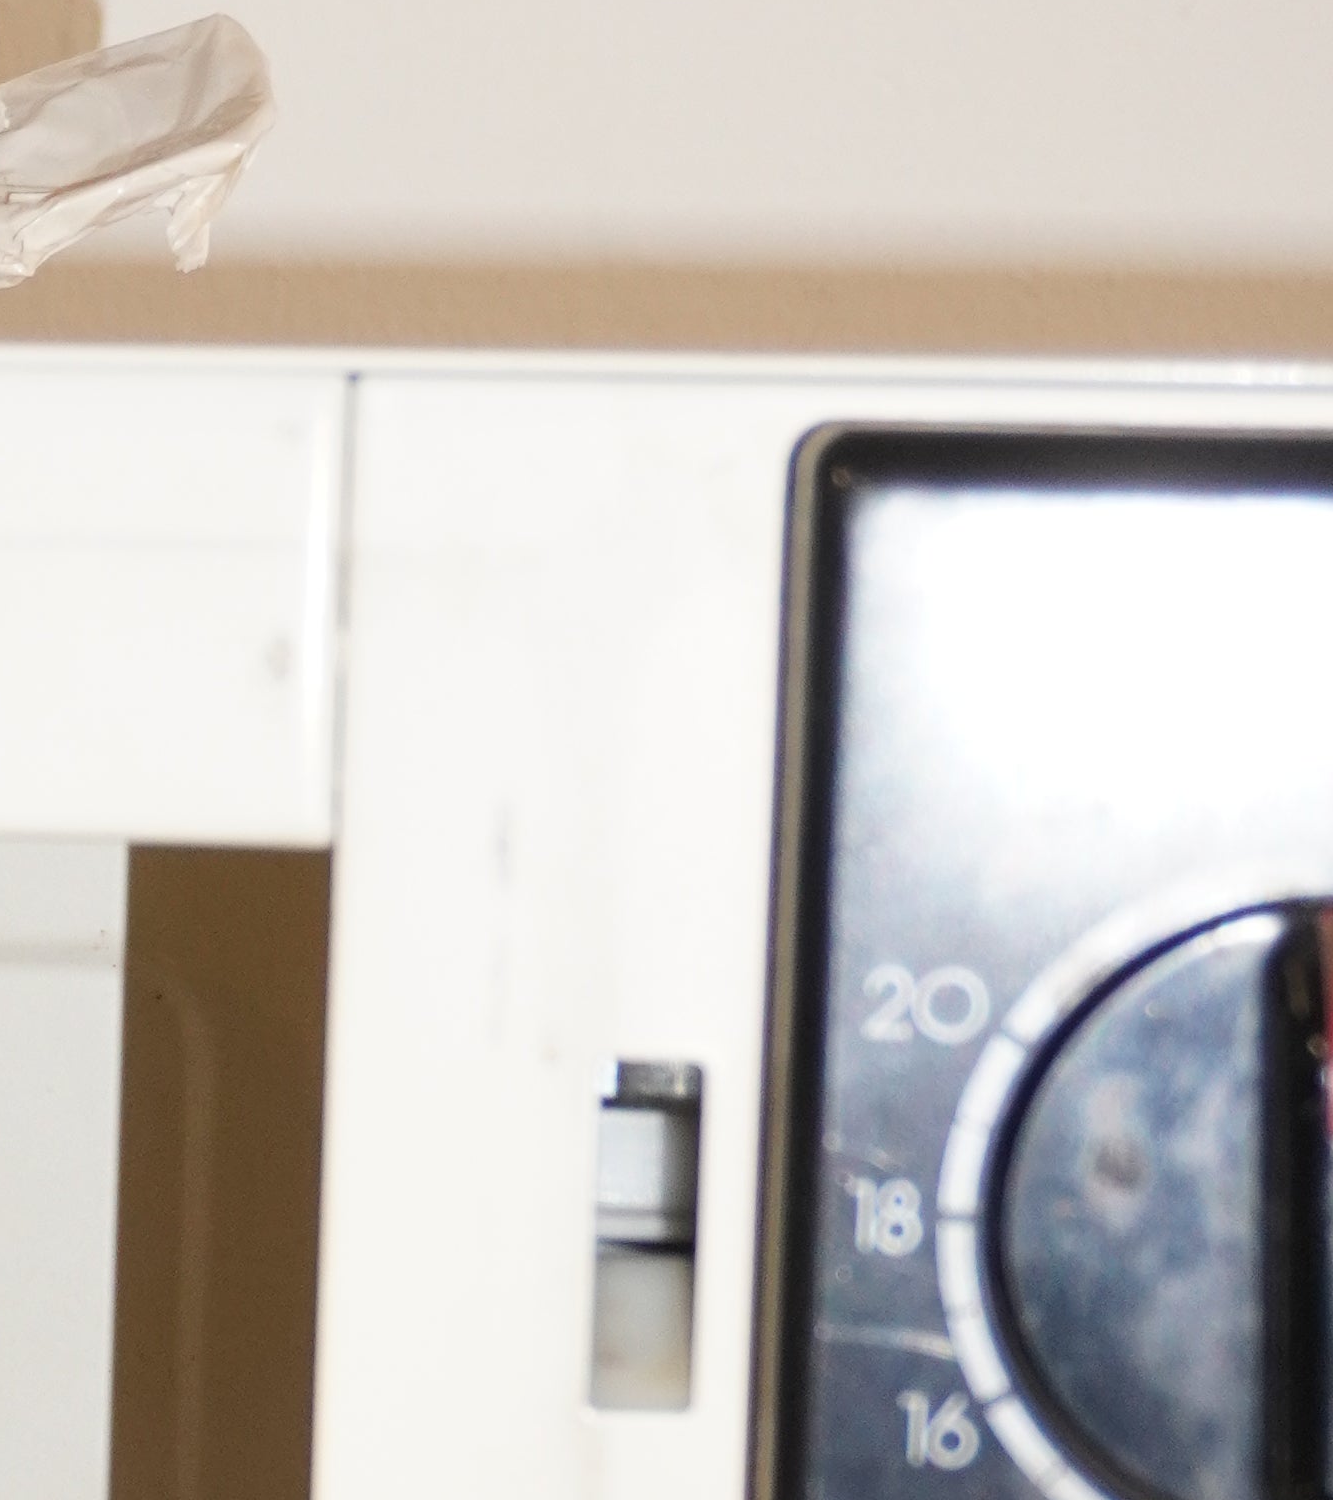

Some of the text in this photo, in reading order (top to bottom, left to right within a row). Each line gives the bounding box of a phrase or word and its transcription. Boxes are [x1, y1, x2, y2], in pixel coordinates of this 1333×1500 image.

[860, 964, 989, 1044] 20
[853, 1179, 923, 1255] 18
[899, 1391, 980, 1470] 16
